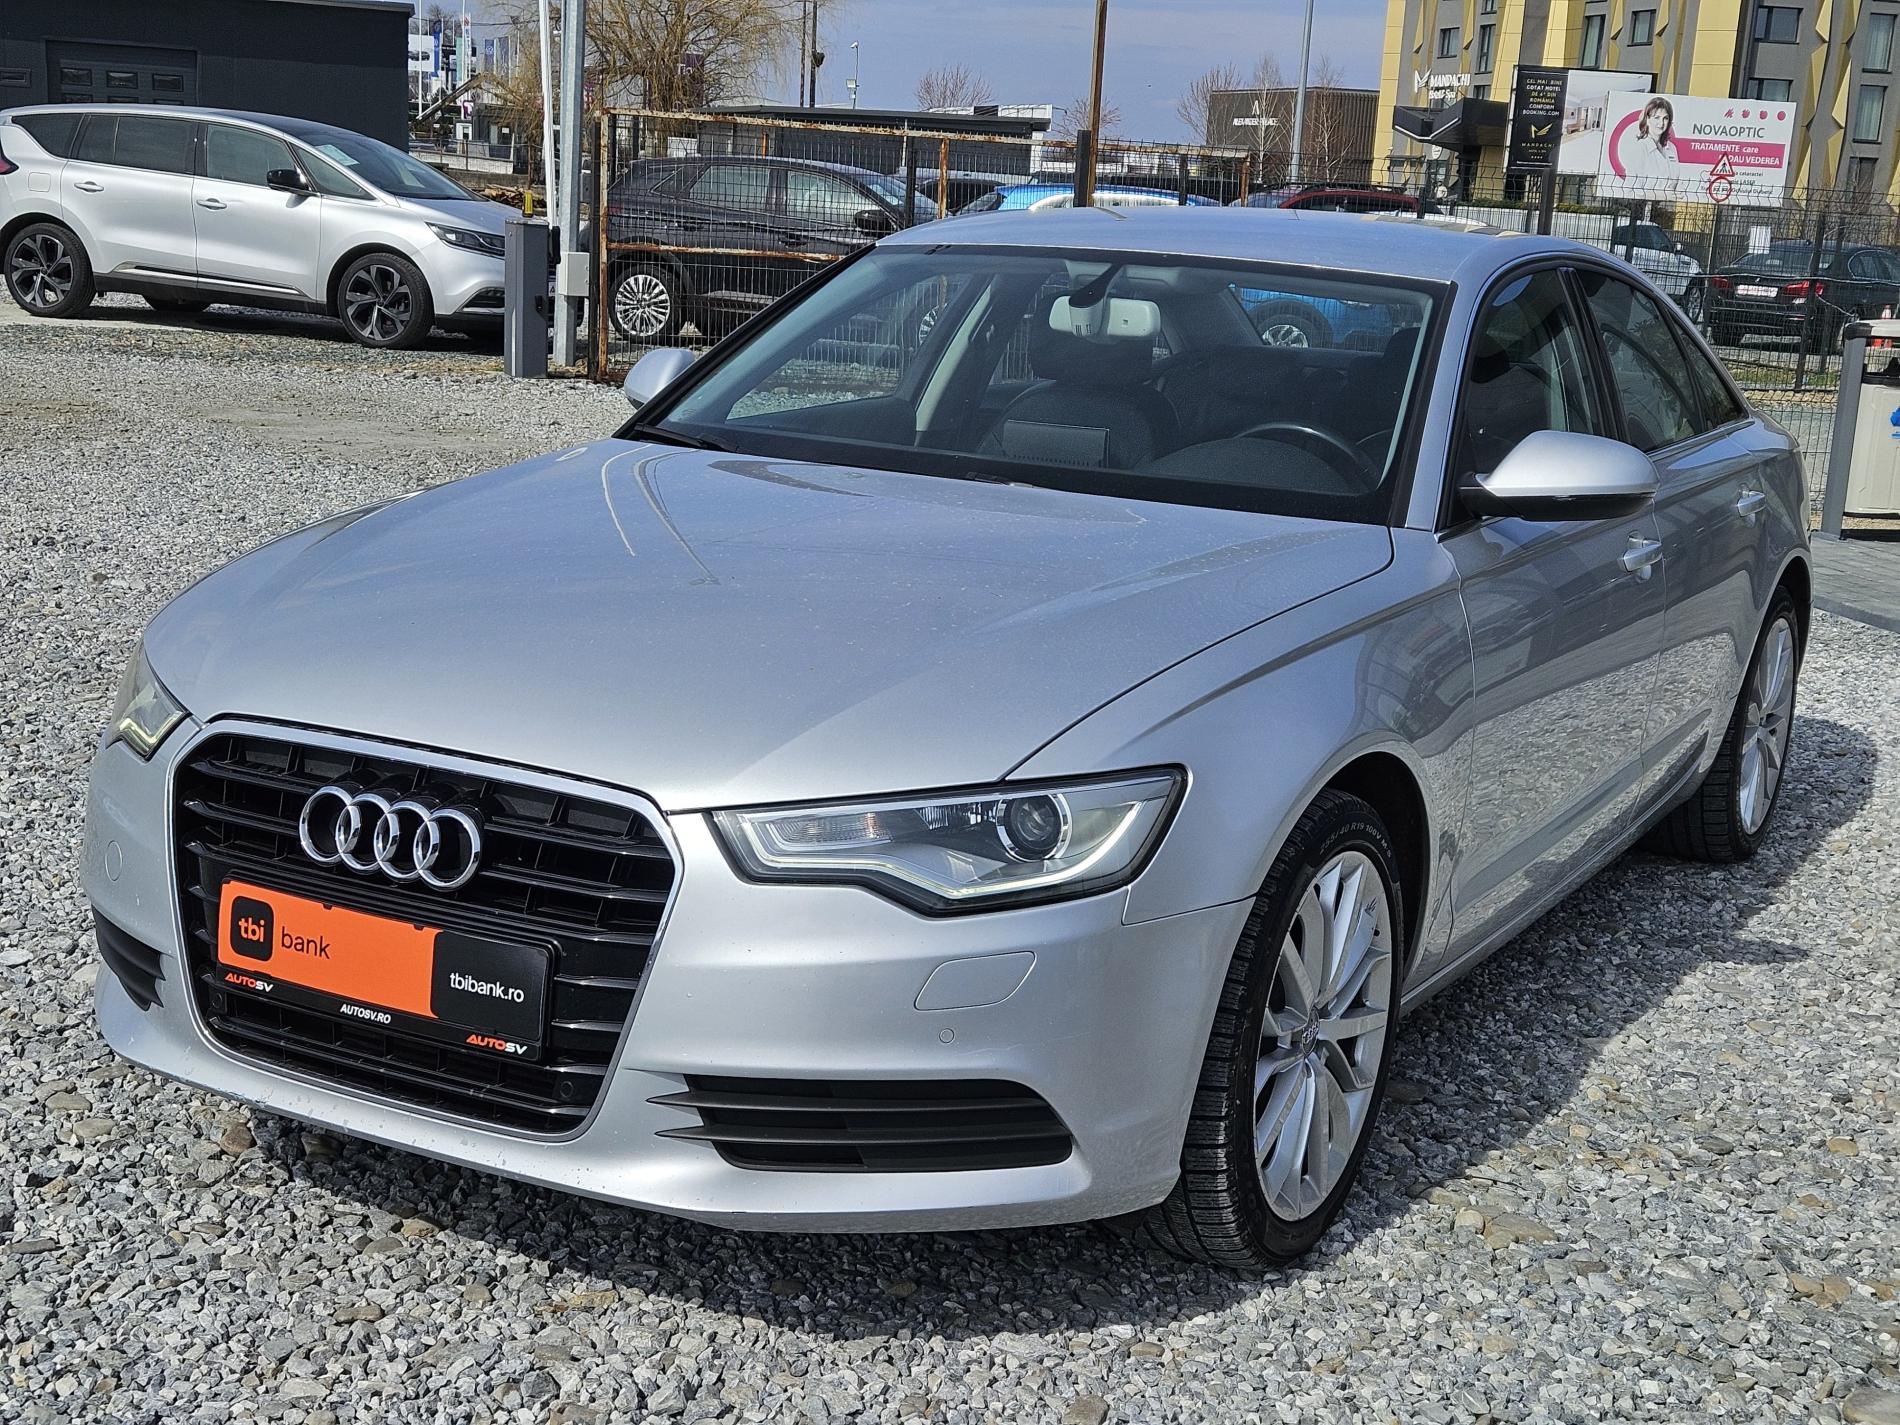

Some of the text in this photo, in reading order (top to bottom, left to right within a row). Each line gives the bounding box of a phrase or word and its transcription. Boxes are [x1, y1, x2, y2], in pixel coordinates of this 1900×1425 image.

[1430, 73, 1471, 87] MANDACHI
[1692, 123, 1766, 139] NOVAOPTIC
[1690, 142, 1759, 153] TRATAMENTE care
[1745, 155, 1780, 165] VEDEREA
[238, 917, 331, 960] tbi bank
[225, 973, 274, 993] AUTOSV
[449, 972, 525, 1003] tbibank.ro
[340, 1003, 392, 1024] AUTOSV.RO
[466, 1034, 528, 1056] AUTOSV
